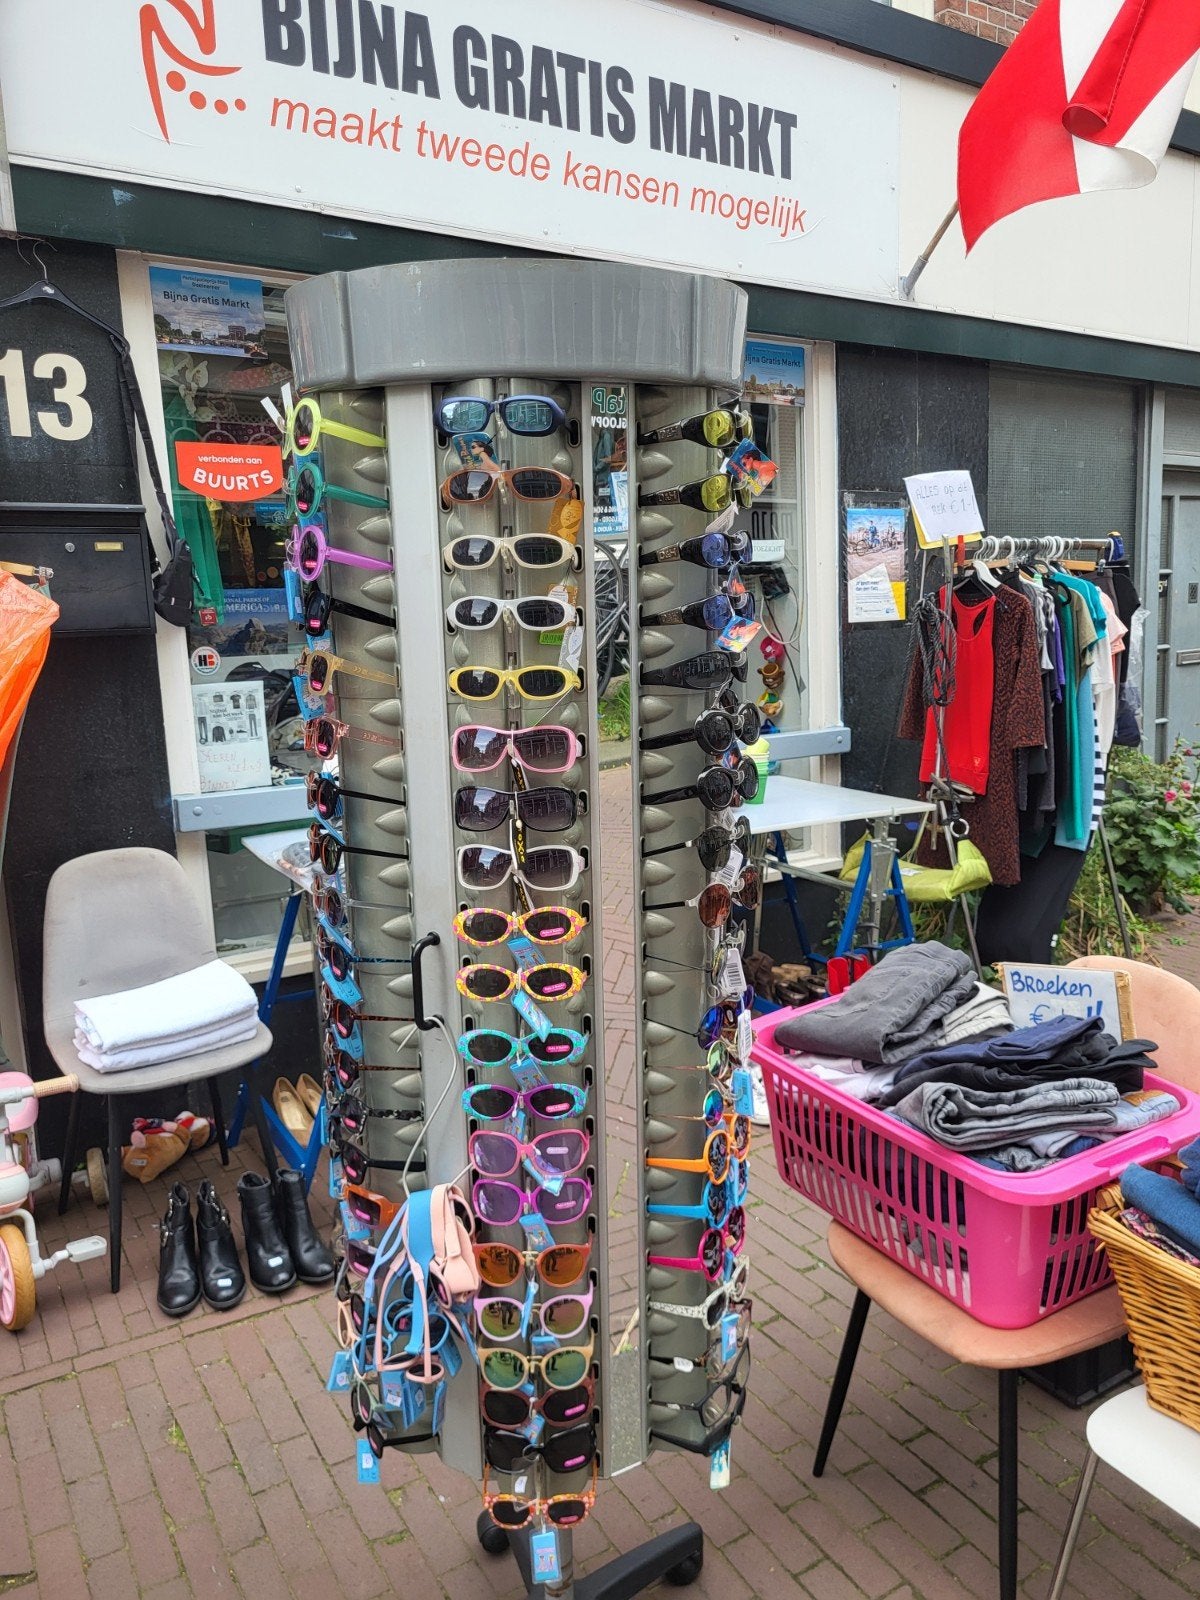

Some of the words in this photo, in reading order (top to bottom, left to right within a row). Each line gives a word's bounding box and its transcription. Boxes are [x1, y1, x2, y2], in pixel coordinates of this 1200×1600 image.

[262, 0, 441, 100] BIJNA
[452, 25, 636, 145] GRATIS
[648, 76, 798, 181] MARKT
[270, 97, 404, 153] maakt
[416, 120, 551, 182] tweede
[563, 151, 680, 208] kansen
[690, 187, 808, 238] mogelijk
[163, 290, 189, 303] Bijna
[190, 294, 220, 306] Gratis
[221, 297, 250, 309] Markt
[761, 356, 781, 366] Gratis
[0, 349, 93, 441] 13
[198, 455, 244, 464] verbonden
[245, 457, 262, 465] aan
[193, 467, 274, 491] BUURTS
[226, 603, 263, 611] MERICA
